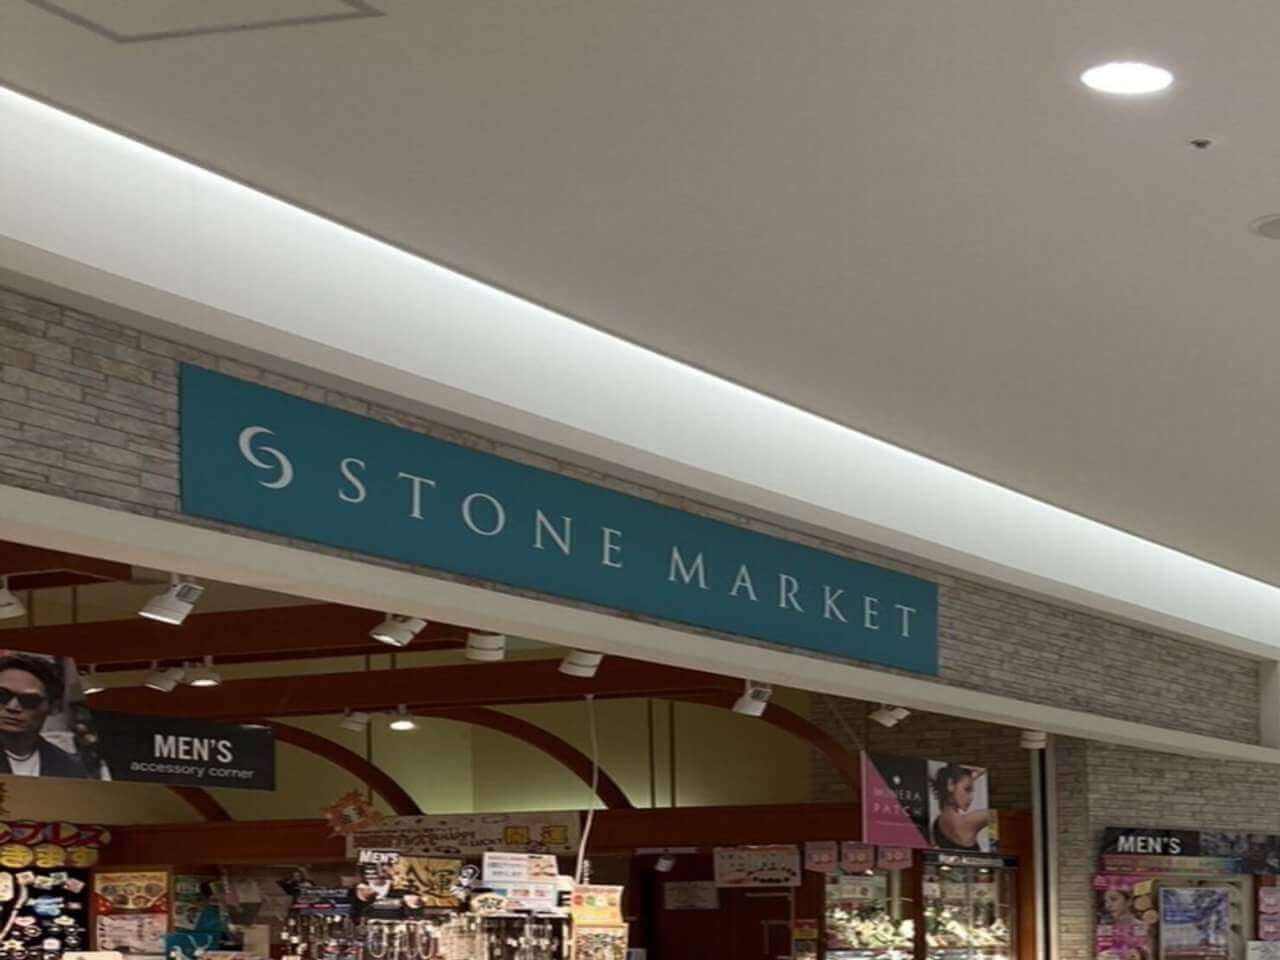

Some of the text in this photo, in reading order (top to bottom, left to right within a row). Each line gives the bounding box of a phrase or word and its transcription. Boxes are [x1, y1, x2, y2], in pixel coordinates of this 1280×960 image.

[337, 456, 918, 638] STONE MARKET
[153, 733, 234, 764] MEN'S
[129, 761, 256, 779] accessory corner
[1117, 835, 1182, 854] MEN'S
